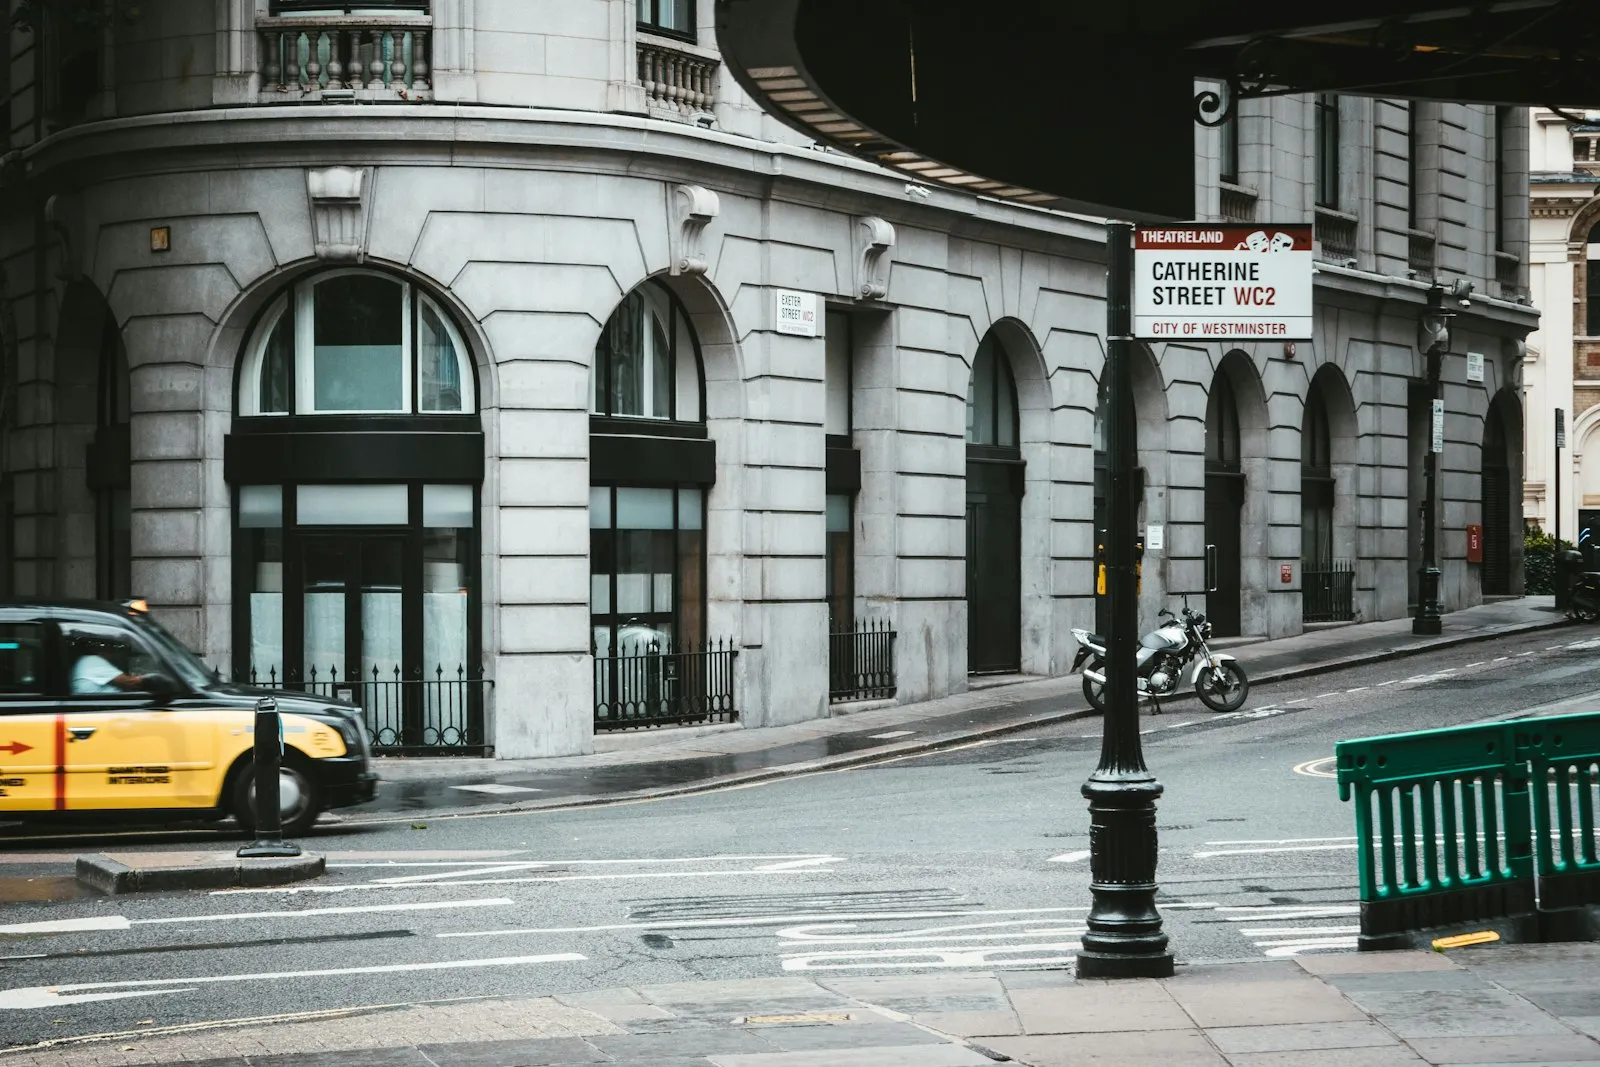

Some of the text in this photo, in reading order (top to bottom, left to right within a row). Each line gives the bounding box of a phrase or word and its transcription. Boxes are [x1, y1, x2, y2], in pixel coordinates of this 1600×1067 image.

[1141, 230, 1224, 244] THEATRELAND
[1152, 261, 1260, 281] CATHERINE
[781, 294, 801, 306] EXETER
[1152, 286, 1276, 306] STREET WC2
[781, 307, 801, 320] STREET
[1152, 322, 1287, 335] CITY OF WESTMINSTER
